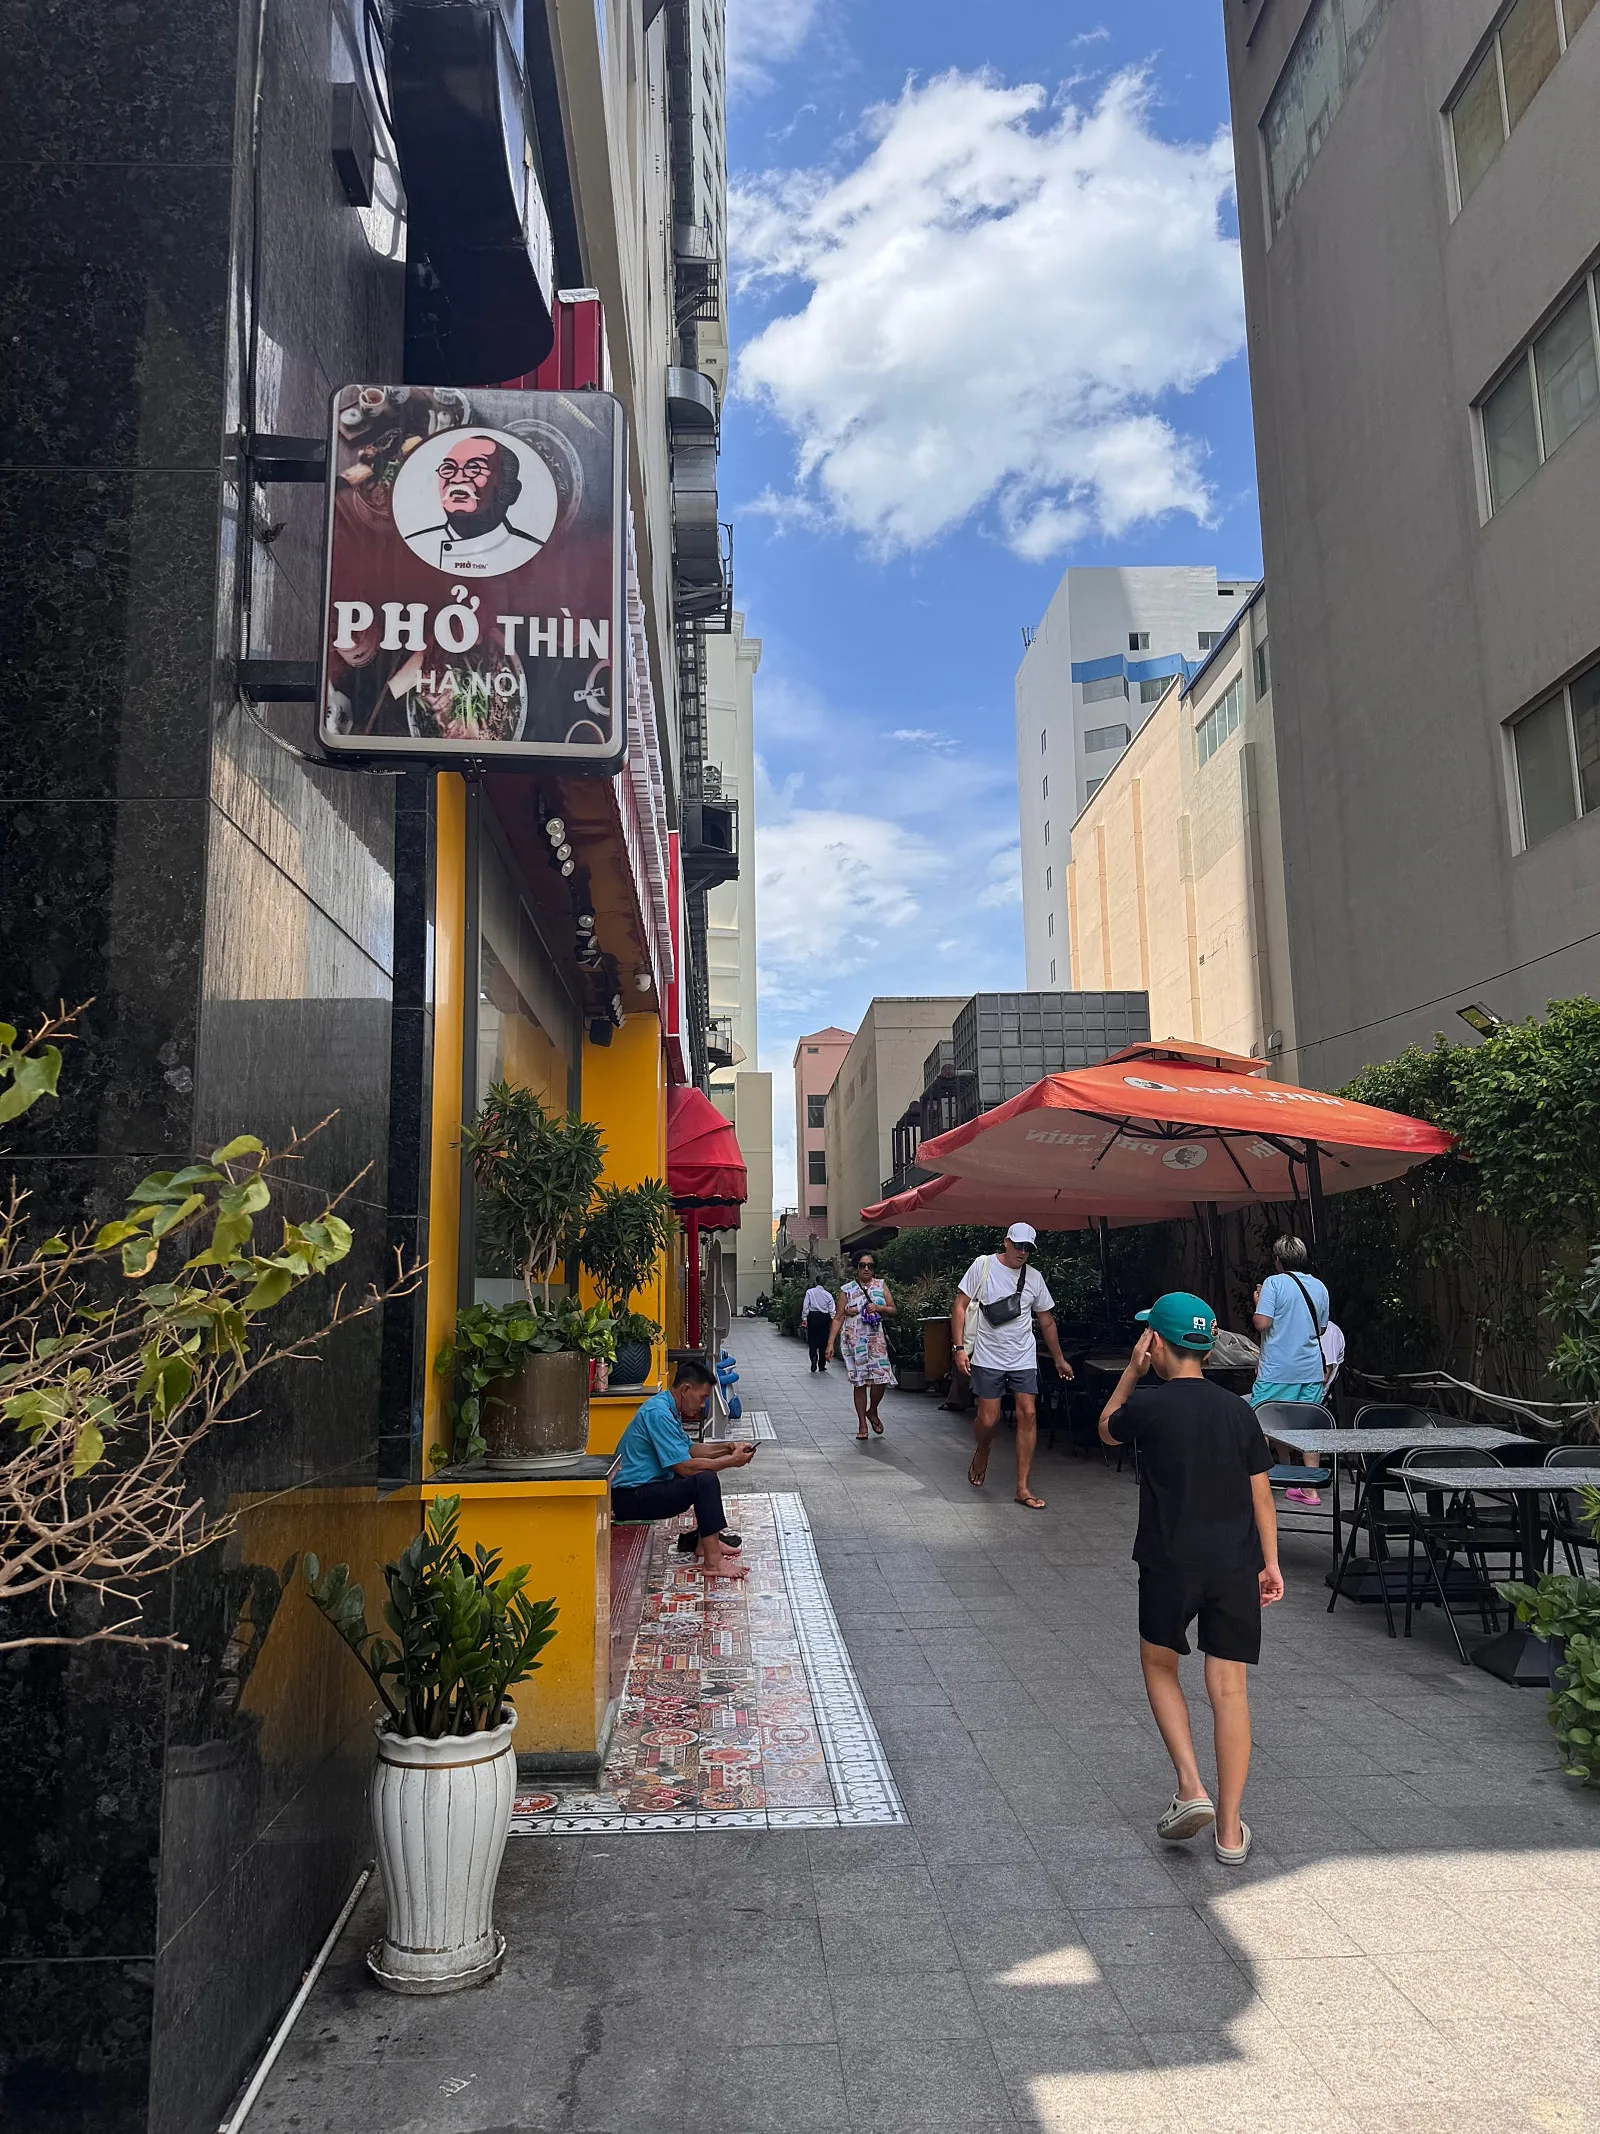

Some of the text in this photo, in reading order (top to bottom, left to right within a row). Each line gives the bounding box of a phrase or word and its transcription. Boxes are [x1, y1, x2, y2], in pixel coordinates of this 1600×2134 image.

[454, 560, 471, 569] PHỞ
[333, 584, 609, 659] PHỞ THÌN
[415, 664, 525, 703] HÀ NỘI
